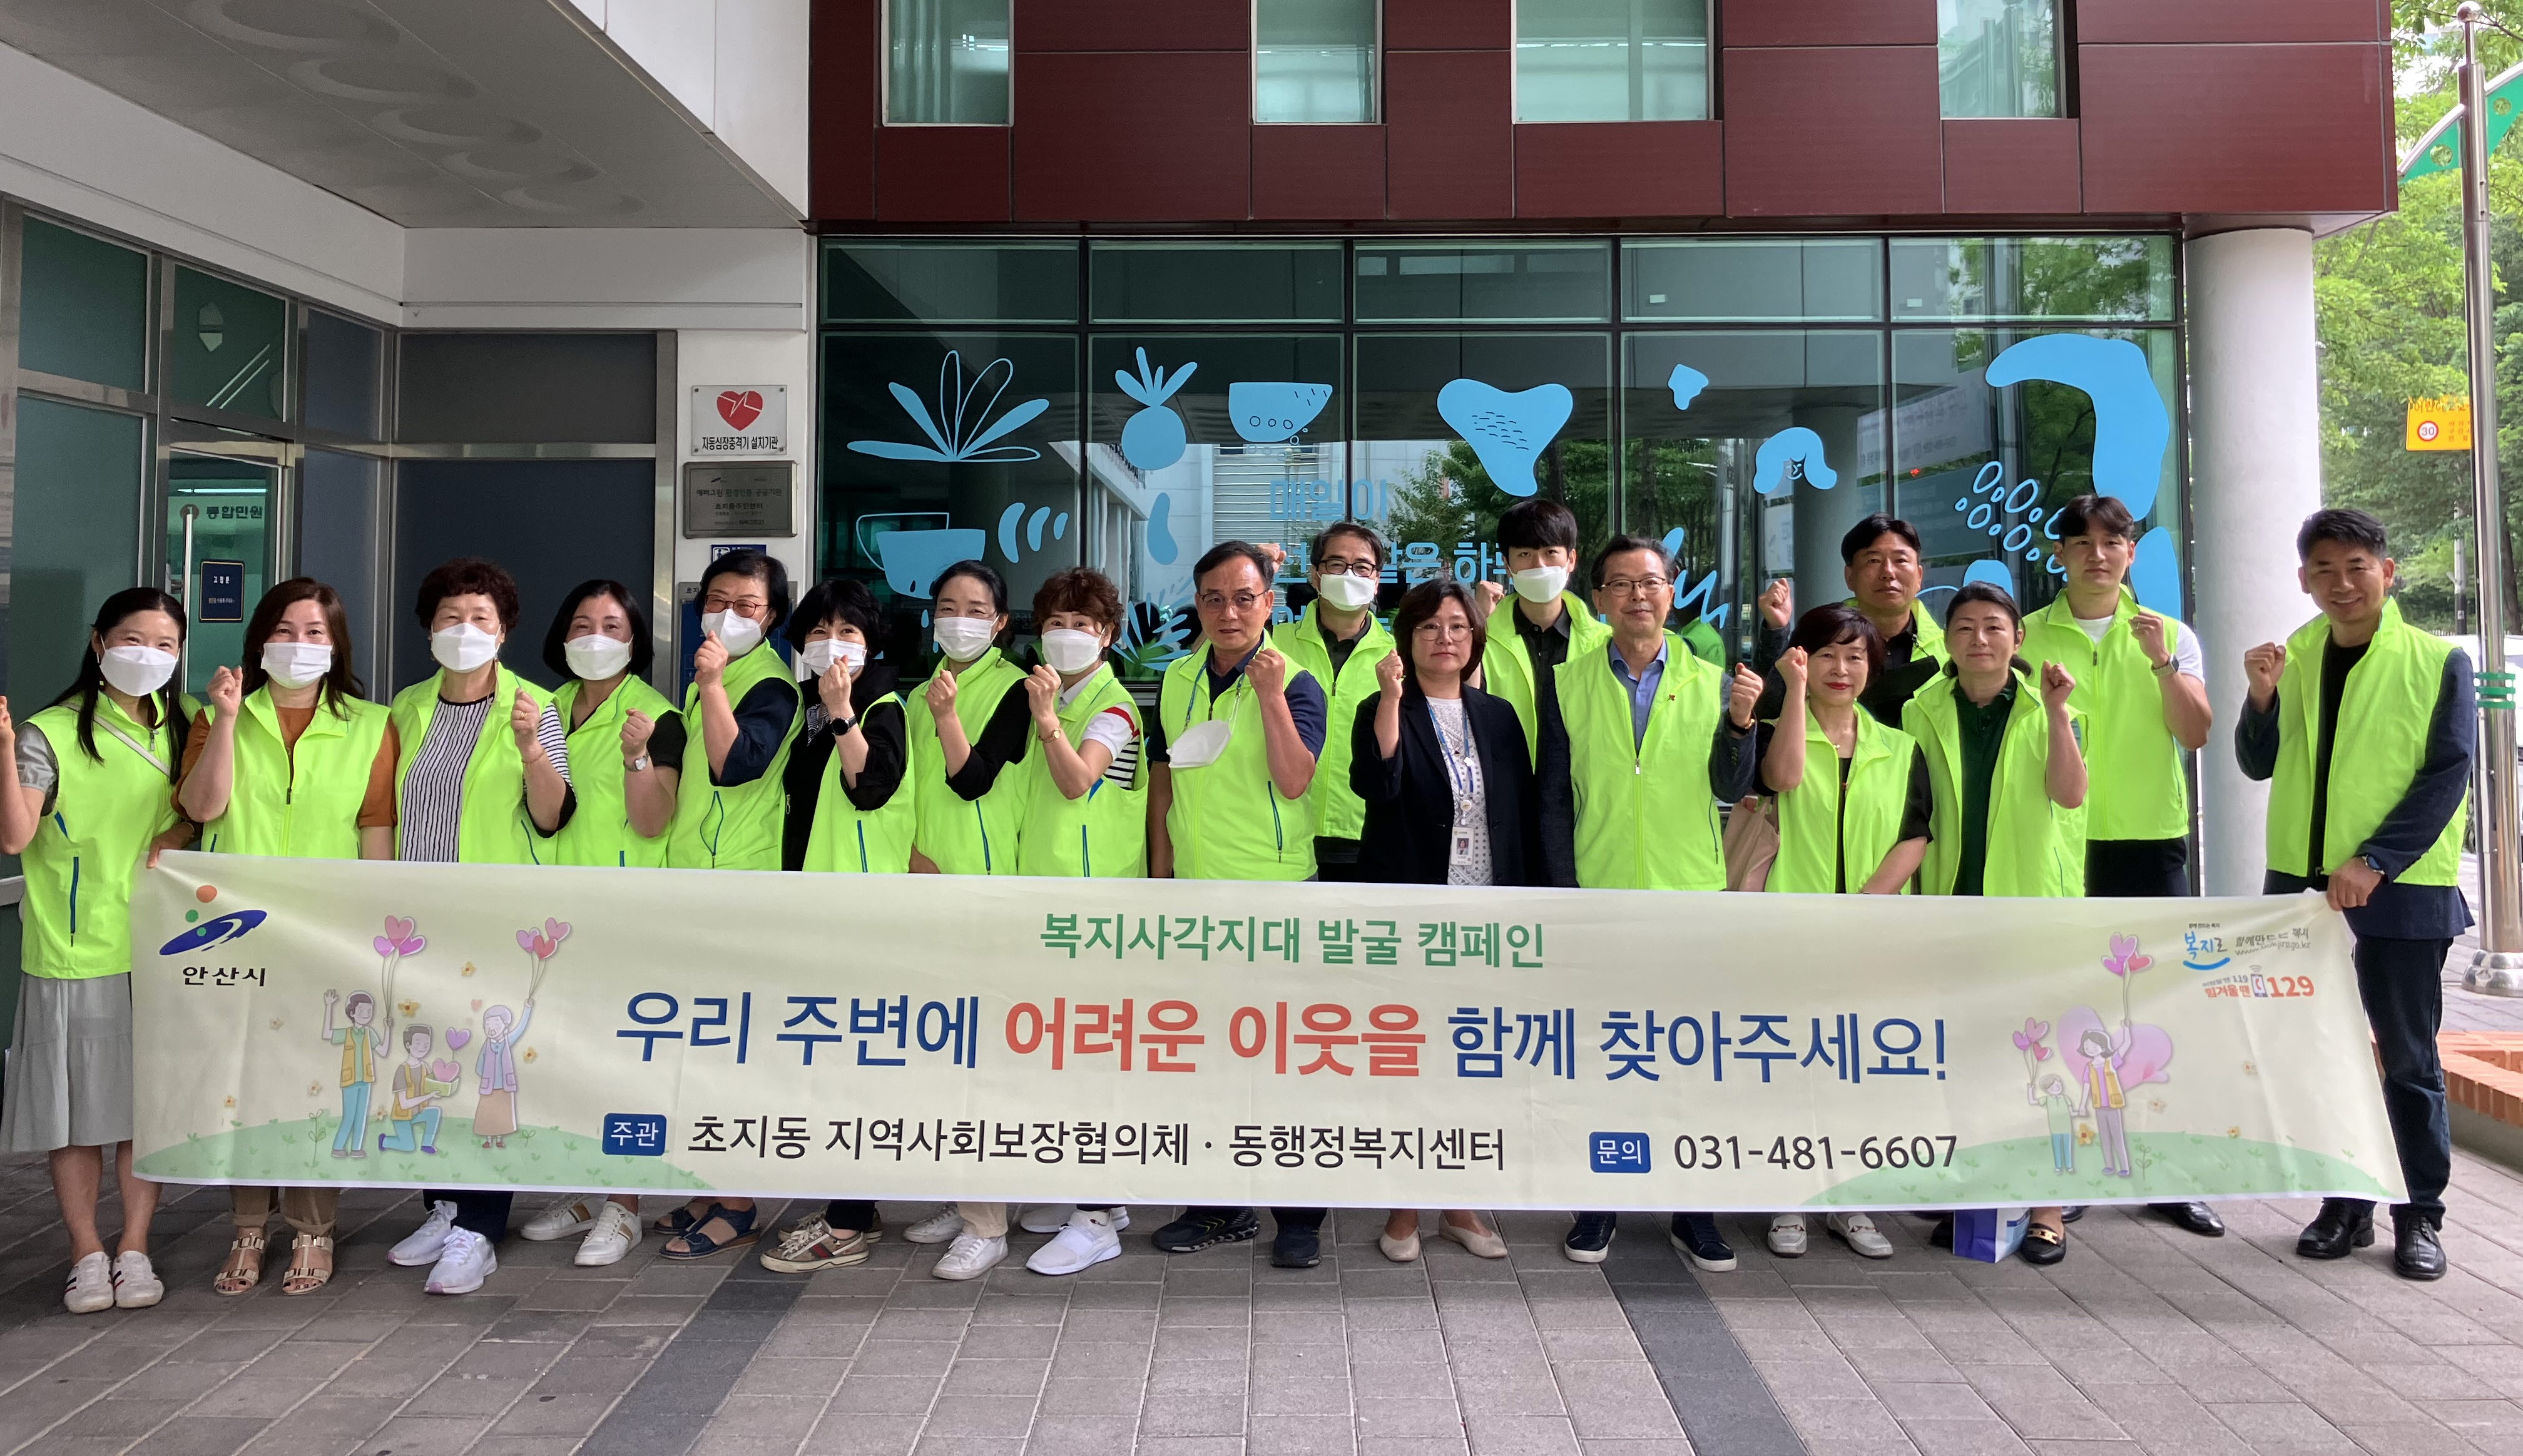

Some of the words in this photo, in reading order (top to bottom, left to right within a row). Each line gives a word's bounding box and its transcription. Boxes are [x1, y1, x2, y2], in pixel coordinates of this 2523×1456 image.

[751, 436, 778, 449] 설치기관
[2422, 427, 2435, 436] 30
[206, 506, 263, 519] 통합민원
[1270, 479, 1387, 521] 매일이
[1039, 913, 1300, 963] 복지사각지대
[1318, 918, 1402, 965] 발굴
[1417, 921, 1544, 969] 캠페인
[2184, 930, 2228, 960] 복지로
[182, 966, 266, 987] 안산시
[2204, 984, 2239, 998] 힘겨울
[2266, 975, 2315, 998] 129
[2232, 974, 2248, 983] 119
[616, 992, 752, 1064] 우리
[776, 994, 979, 1069] 주변에
[1005, 997, 1205, 1073] 어려운
[1228, 1001, 1426, 1077] 이웃을
[1447, 1005, 1576, 1080] 함께
[1599, 1009, 1947, 1084] 찾아주세요!
[610, 1121, 659, 1147] 주관
[688, 1114, 812, 1159] 초지동
[825, 1117, 1188, 1165] 지역사회보장협의체
[1228, 1124, 1504, 1170] 동행정복지센터
[1596, 1139, 1642, 1165] 문의
[1673, 1134, 1959, 1171] 031-481-6607
